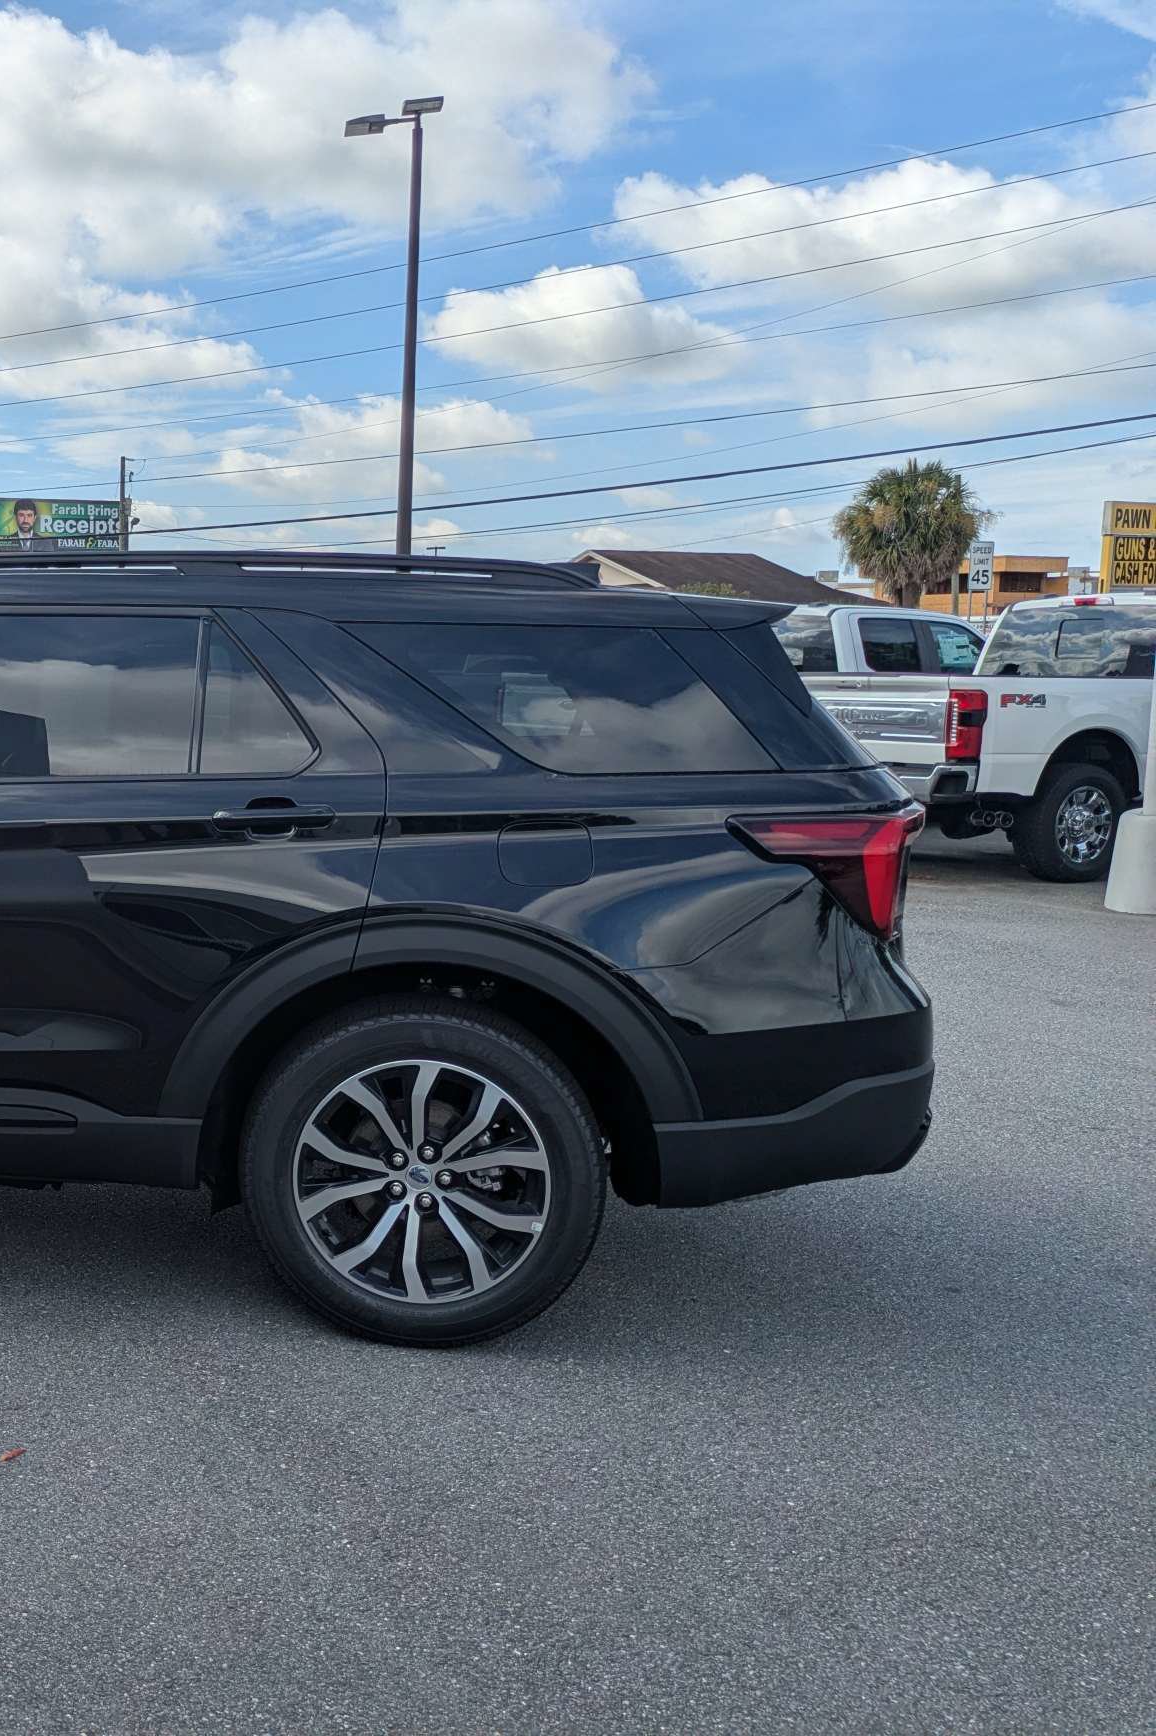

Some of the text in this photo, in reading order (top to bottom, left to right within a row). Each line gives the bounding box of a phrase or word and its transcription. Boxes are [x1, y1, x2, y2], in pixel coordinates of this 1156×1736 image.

[51, 504, 119, 517] Farah Bring
[1114, 508, 1151, 529] PAWN
[57, 536, 120, 549] FARAH & FARA
[1115, 538, 1156, 560] GUNS &
[972, 546, 992, 554] SPEED
[973, 558, 990, 566] LIMIT
[971, 569, 990, 585] 45
[1114, 562, 1156, 585] CASH FO
[1000, 694, 1046, 705] FX4
